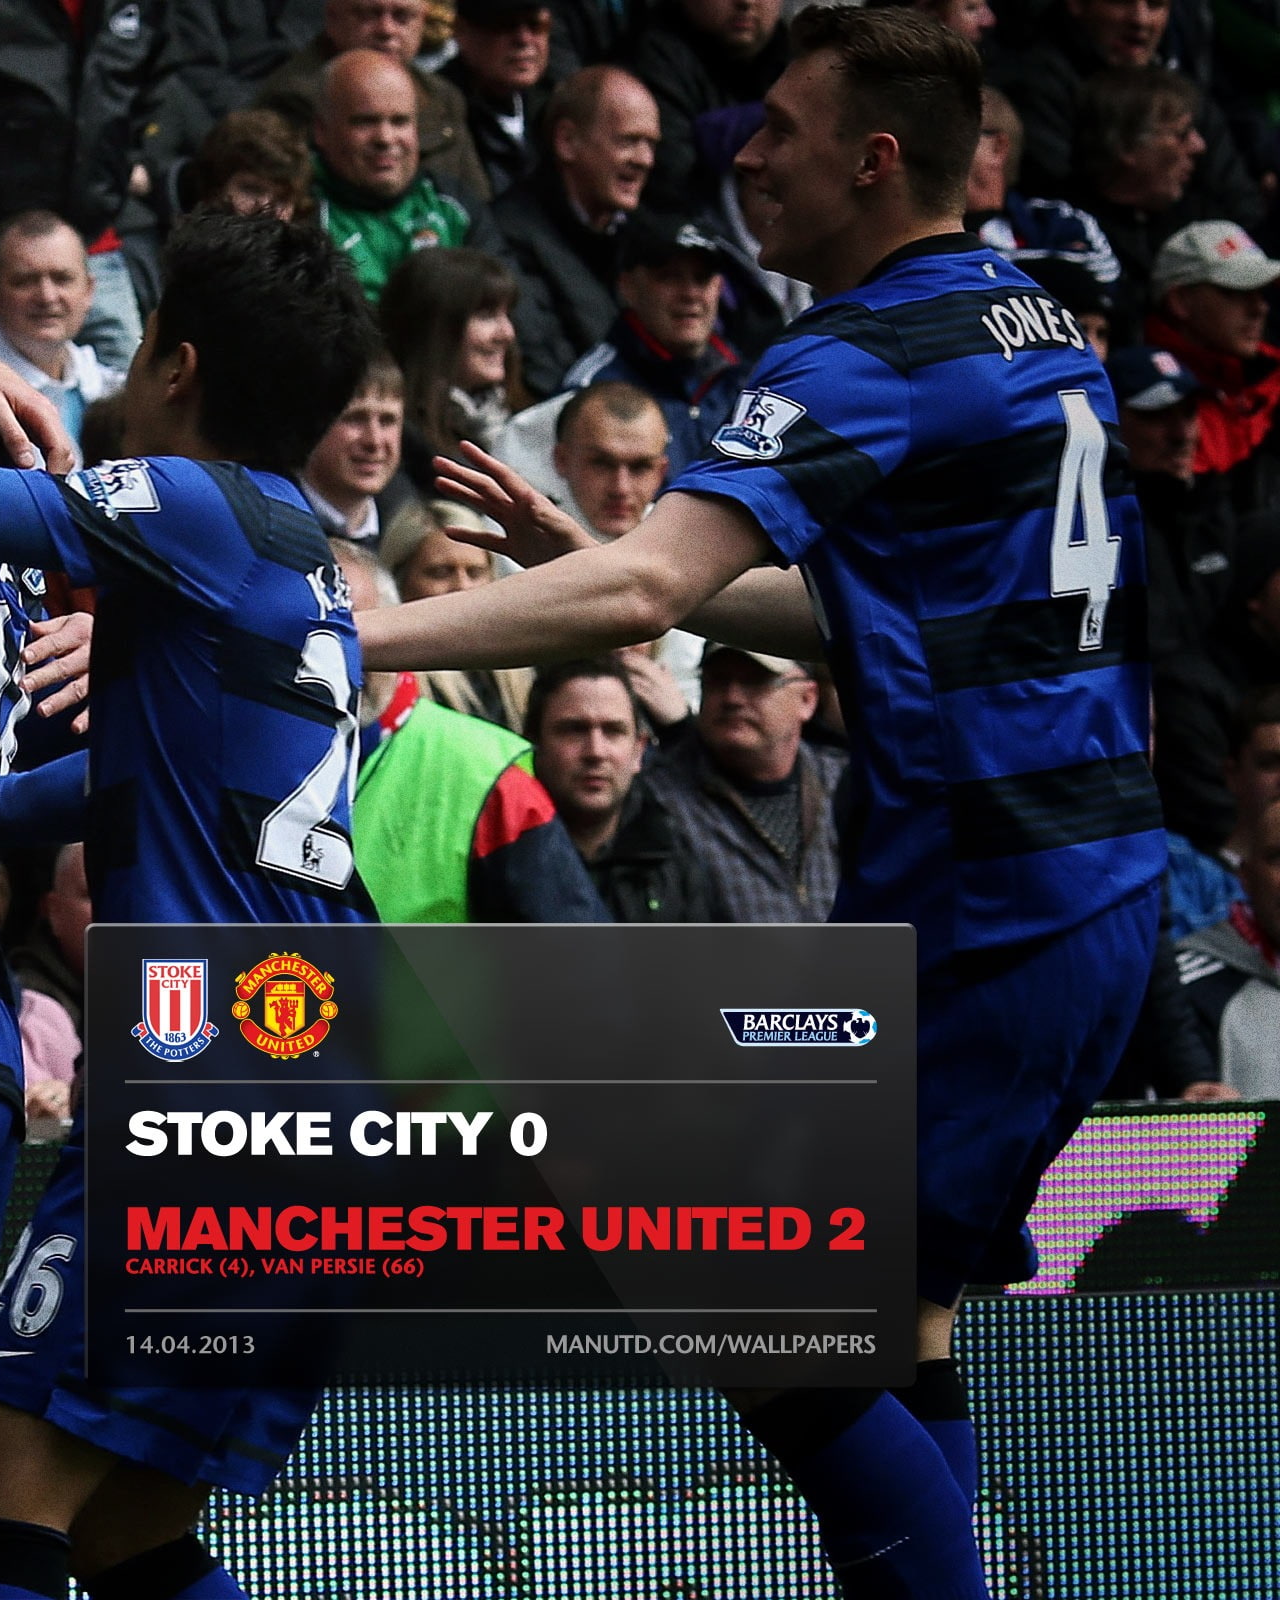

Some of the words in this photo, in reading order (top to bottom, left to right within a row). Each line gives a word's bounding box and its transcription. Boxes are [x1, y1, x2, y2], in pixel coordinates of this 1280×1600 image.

[981, 295, 1086, 362] JONES
[1051, 389, 1121, 651] 4
[255, 629, 361, 891] 2
